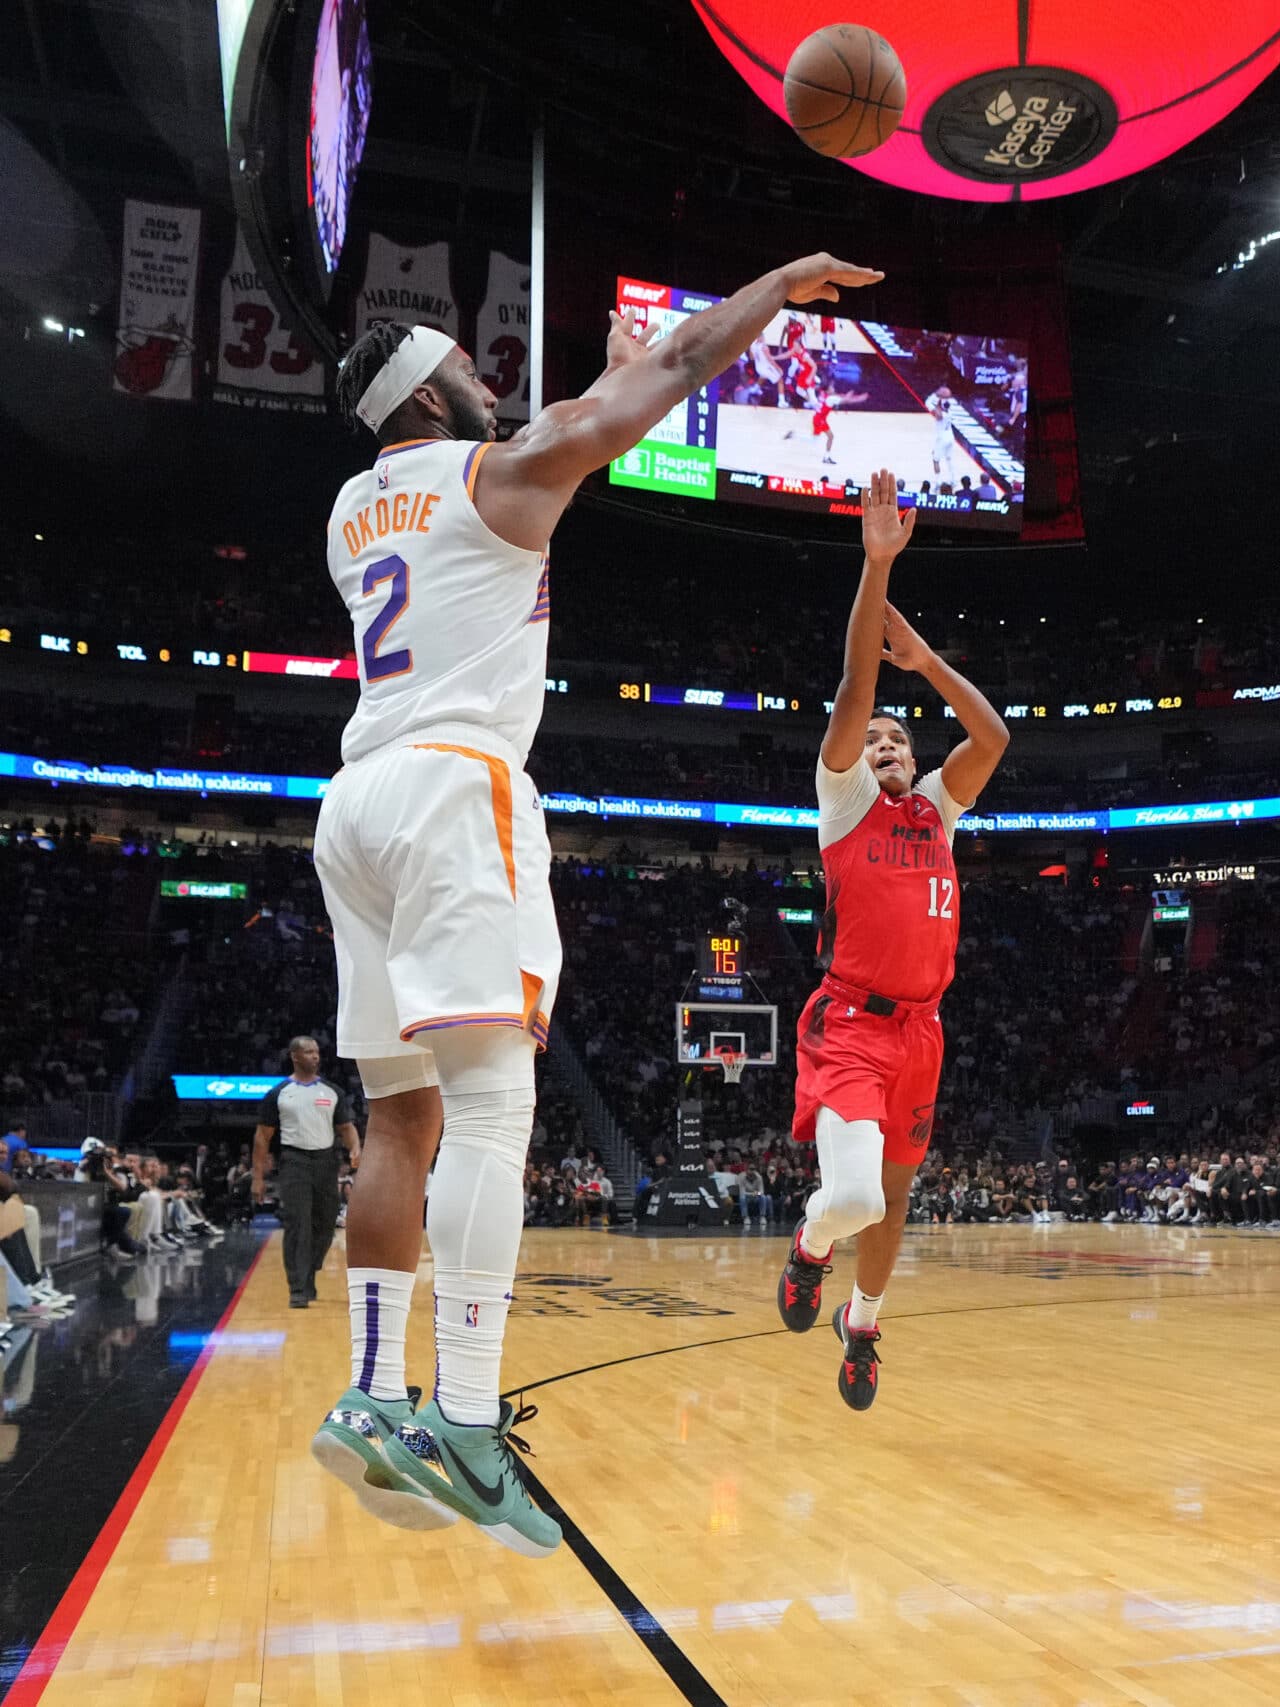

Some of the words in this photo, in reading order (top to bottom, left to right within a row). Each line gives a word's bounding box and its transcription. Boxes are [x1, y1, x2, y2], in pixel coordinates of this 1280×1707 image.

[984, 96, 1049, 165] Kaseya
[1015, 101, 1077, 168] Center
[364, 289, 452, 321] HARDAWAY
[622, 283, 666, 303] HEAT
[498, 303, 530, 325] O'N
[223, 303, 313, 374] 33
[482, 335, 530, 398] 3
[653, 451, 711, 473] Baptist
[654, 465, 708, 488] Health
[343, 492, 442, 558] OKOGIE
[829, 503, 866, 516] MIAM
[362, 554, 414, 684] 2
[41, 635, 70, 652] BLK
[117, 645, 146, 660] TOL
[285, 659, 341, 678] HEAT
[619, 683, 640, 699] 38
[790, 700, 800, 711] 0
[914, 706, 923, 718] 2
[1004, 704, 1028, 718] AST
[1032, 705, 1047, 718] 12
[1126, 699, 1153, 713] FG%
[1158, 697, 1182, 711] 42.9
[33, 760, 154, 789] Game-changing
[156, 771, 203, 790] health
[205, 776, 272, 794] solutions
[539, 796, 597, 815] changing
[599, 798, 641, 815] health
[643, 802, 702, 819] solutions
[741, 808, 793, 825] Florida
[997, 814, 1037, 830] health
[1039, 815, 1097, 830] solutions
[1136, 808, 1189, 824] Florida
[1192, 806, 1224, 821] Blue
[868, 838, 951, 870] CULTUR
[928, 876, 953, 919] 12
[711, 938, 739, 952] 8:01
[715, 951, 737, 974] 16
[667, 1191, 700, 1199] American
[674, 1198, 700, 1206] Airlines
